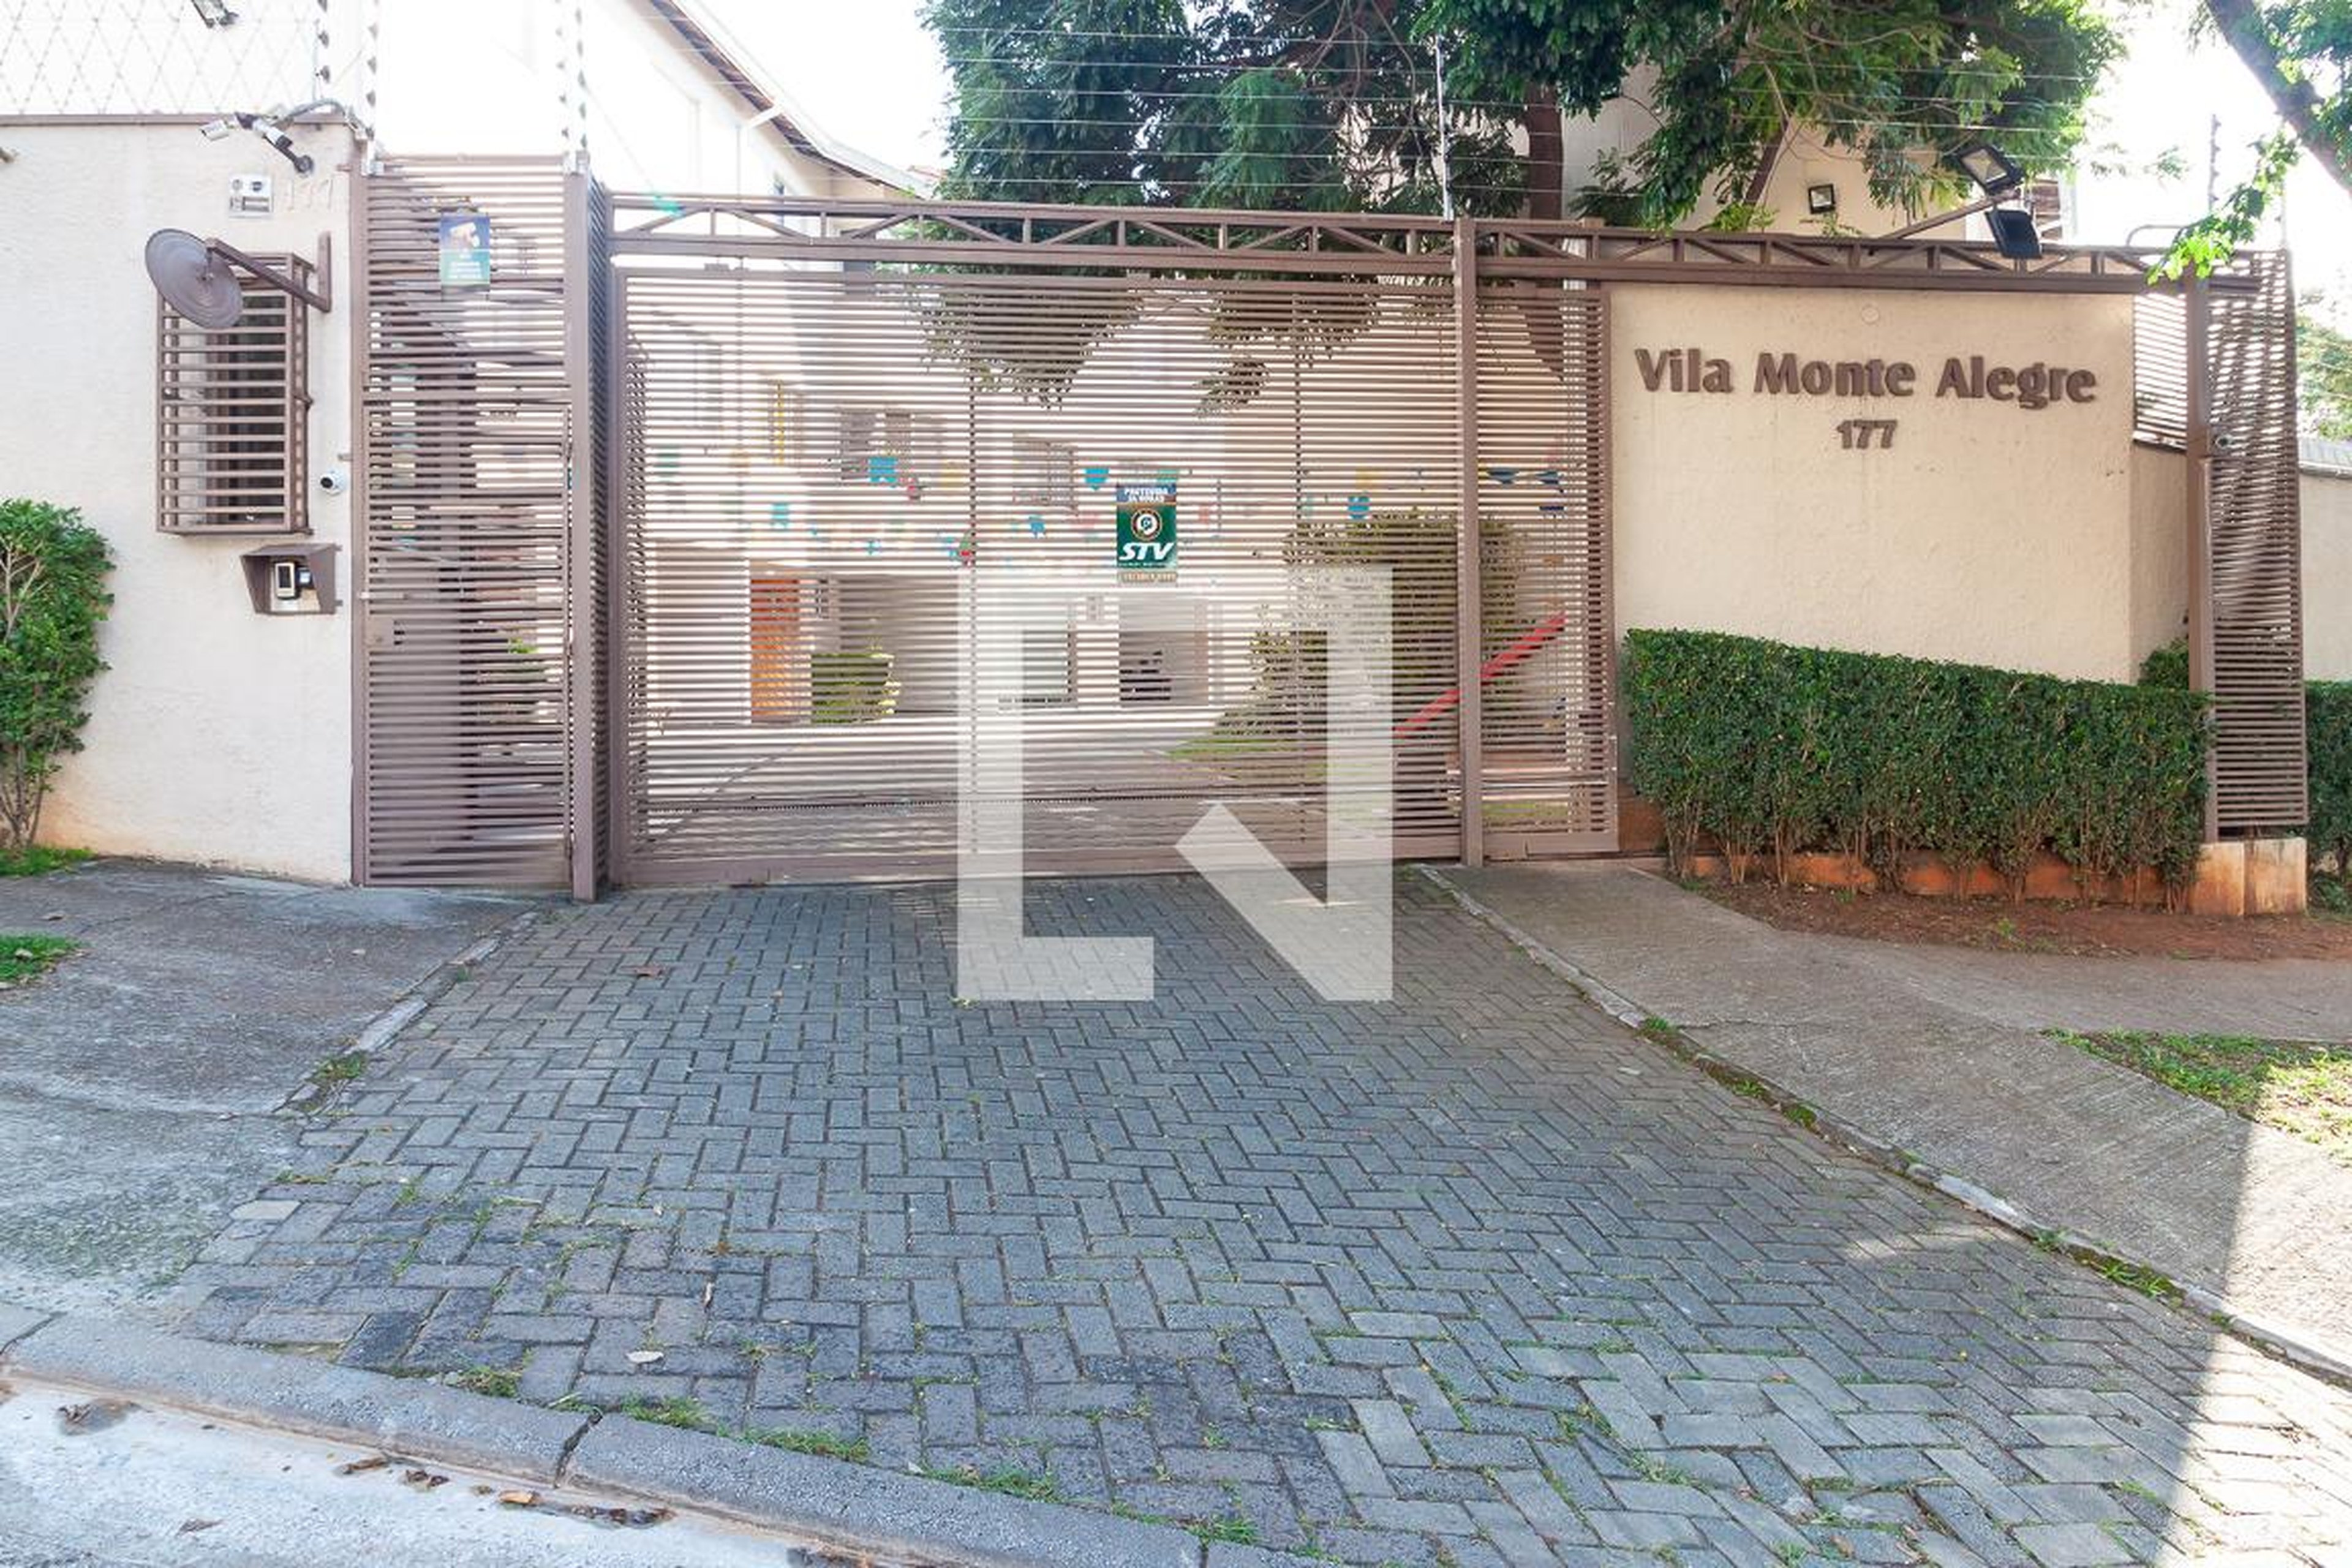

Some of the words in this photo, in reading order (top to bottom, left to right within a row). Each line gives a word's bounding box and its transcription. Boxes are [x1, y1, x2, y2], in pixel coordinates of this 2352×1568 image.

[1634, 348, 1734, 393] Vila
[1753, 351, 1916, 397] Monte
[1935, 355, 2097, 410] Alegre
[1836, 419, 1898, 450] 177
[1118, 541, 1175, 560] STV
